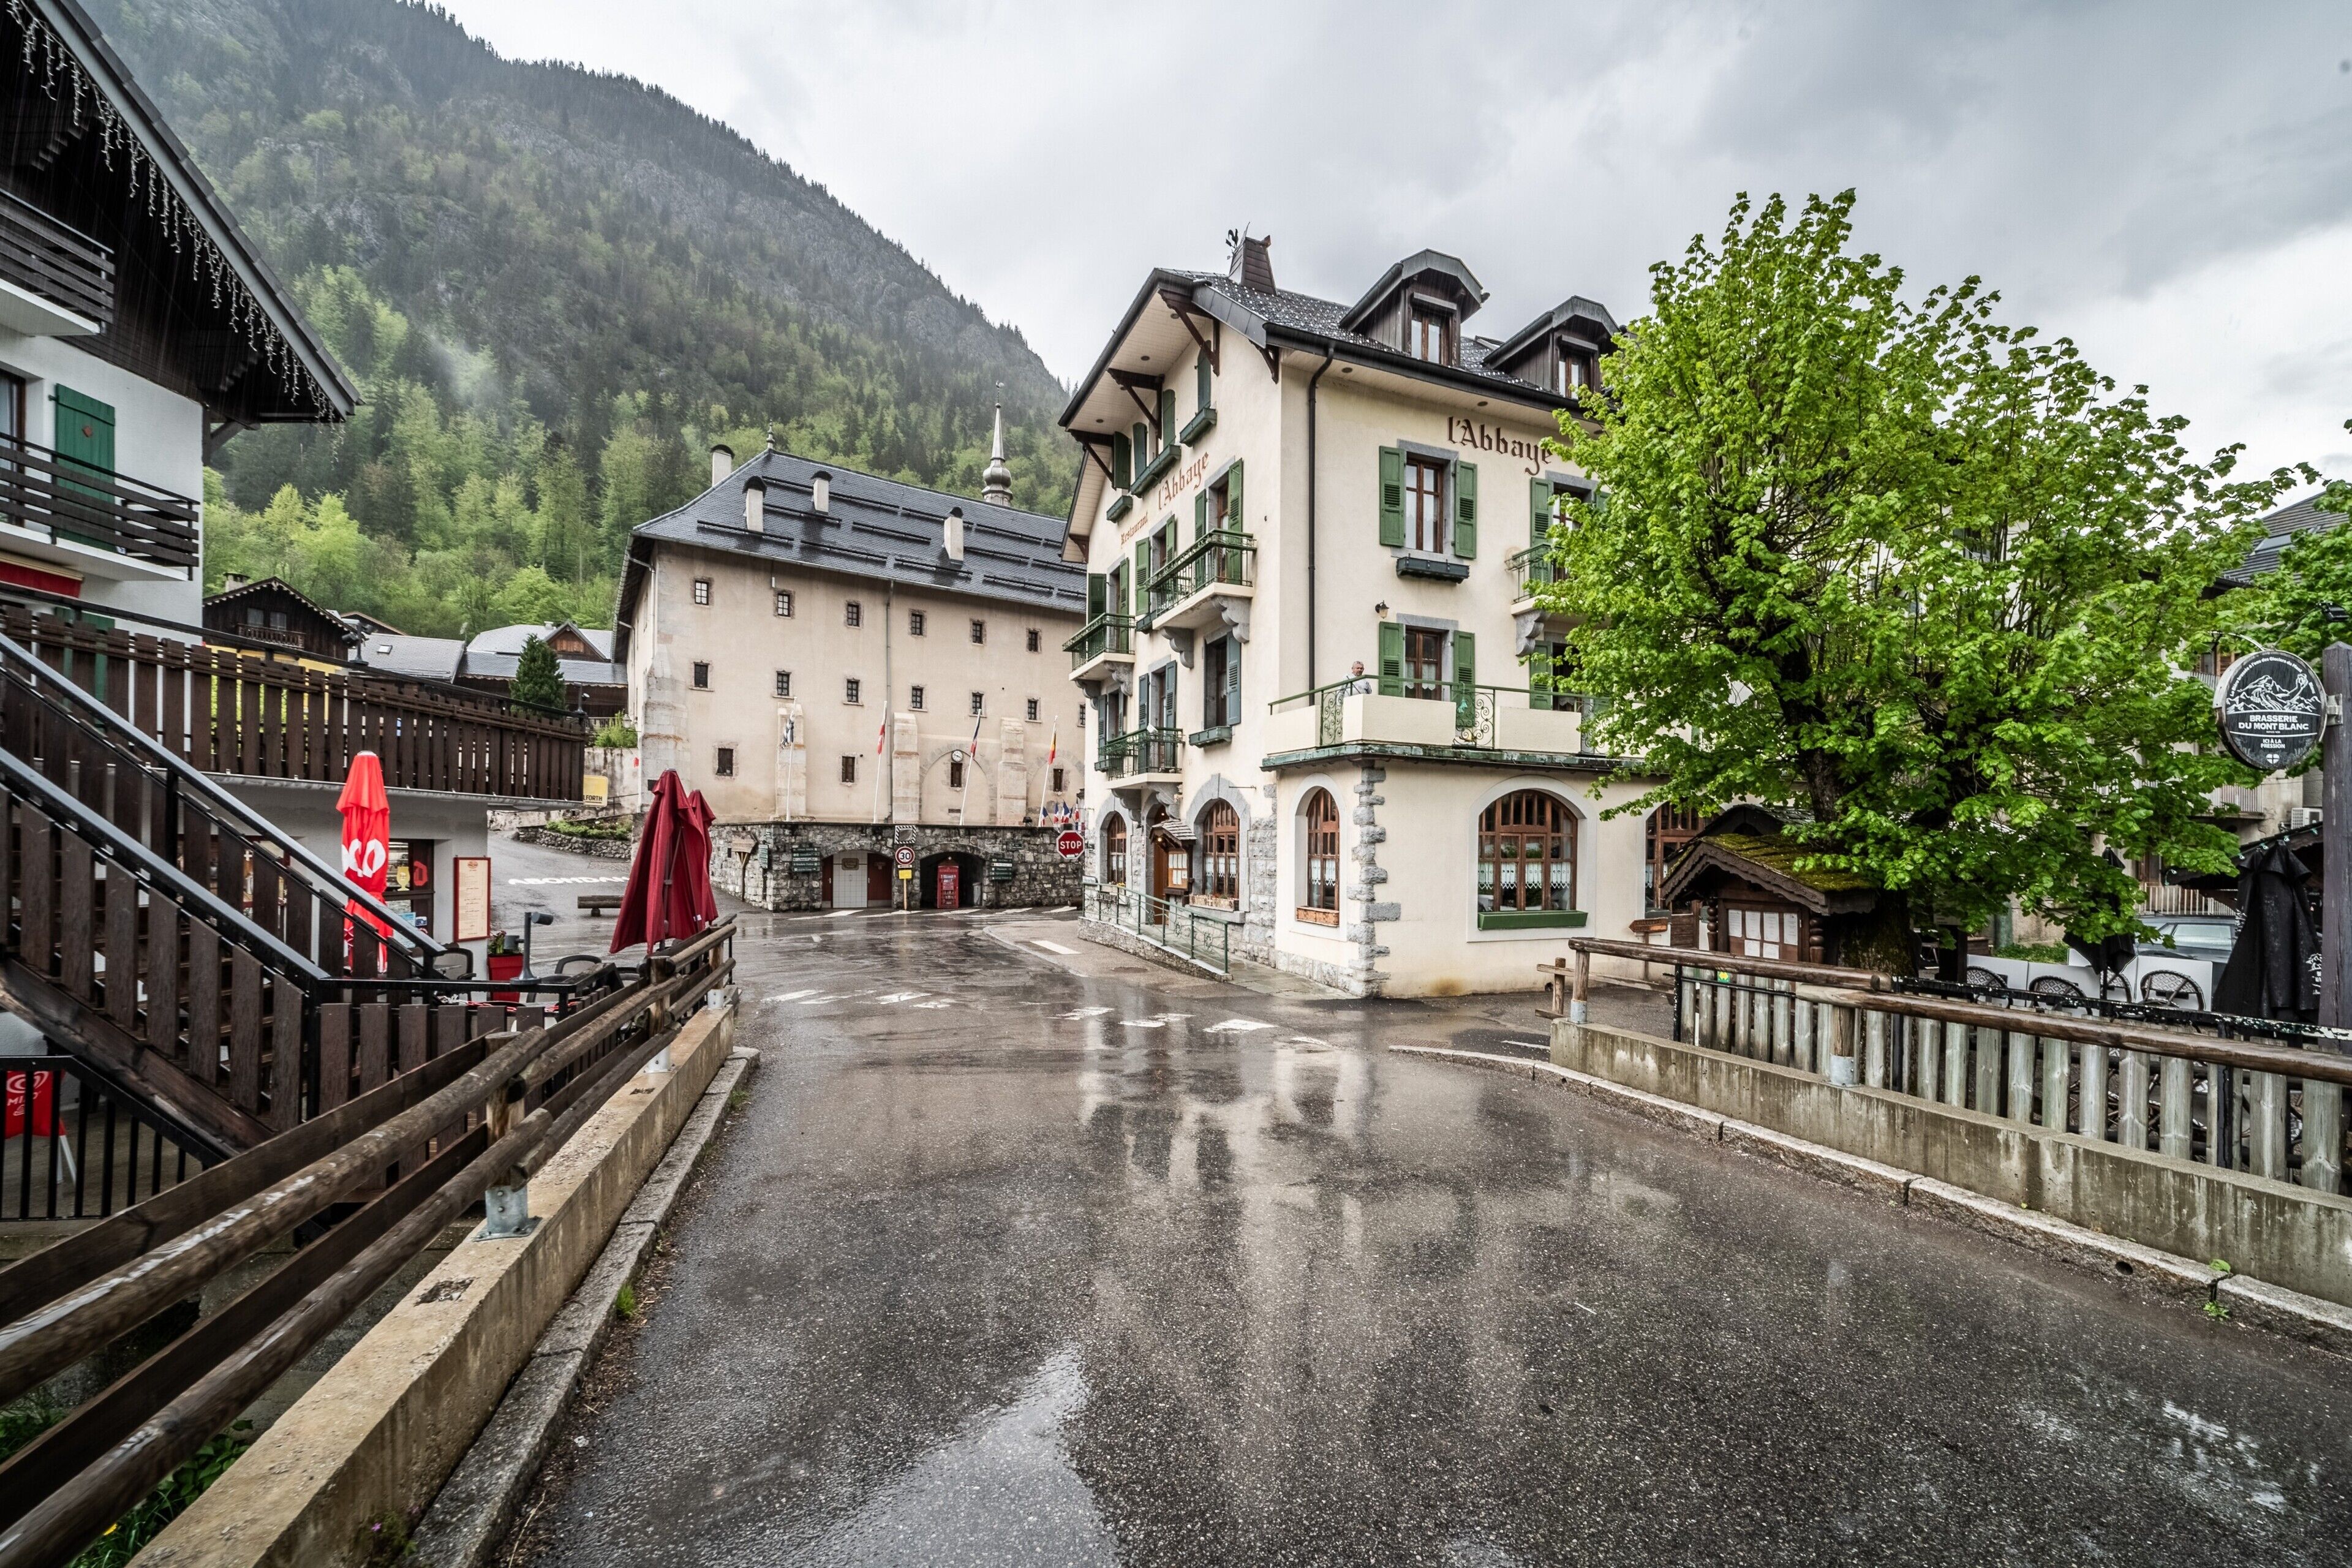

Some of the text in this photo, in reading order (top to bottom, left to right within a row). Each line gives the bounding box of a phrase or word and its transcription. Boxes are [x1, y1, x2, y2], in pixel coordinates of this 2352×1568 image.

[1447, 417, 1553, 476] l'Abbaye
[1158, 451, 1209, 510] l'Abbaye
[1120, 511, 1148, 549] Restaurant
[2292, 663, 2302, 673] Mont
[1060, 840, 1082, 850] STOP
[7, 1092, 38, 1106] MIO
